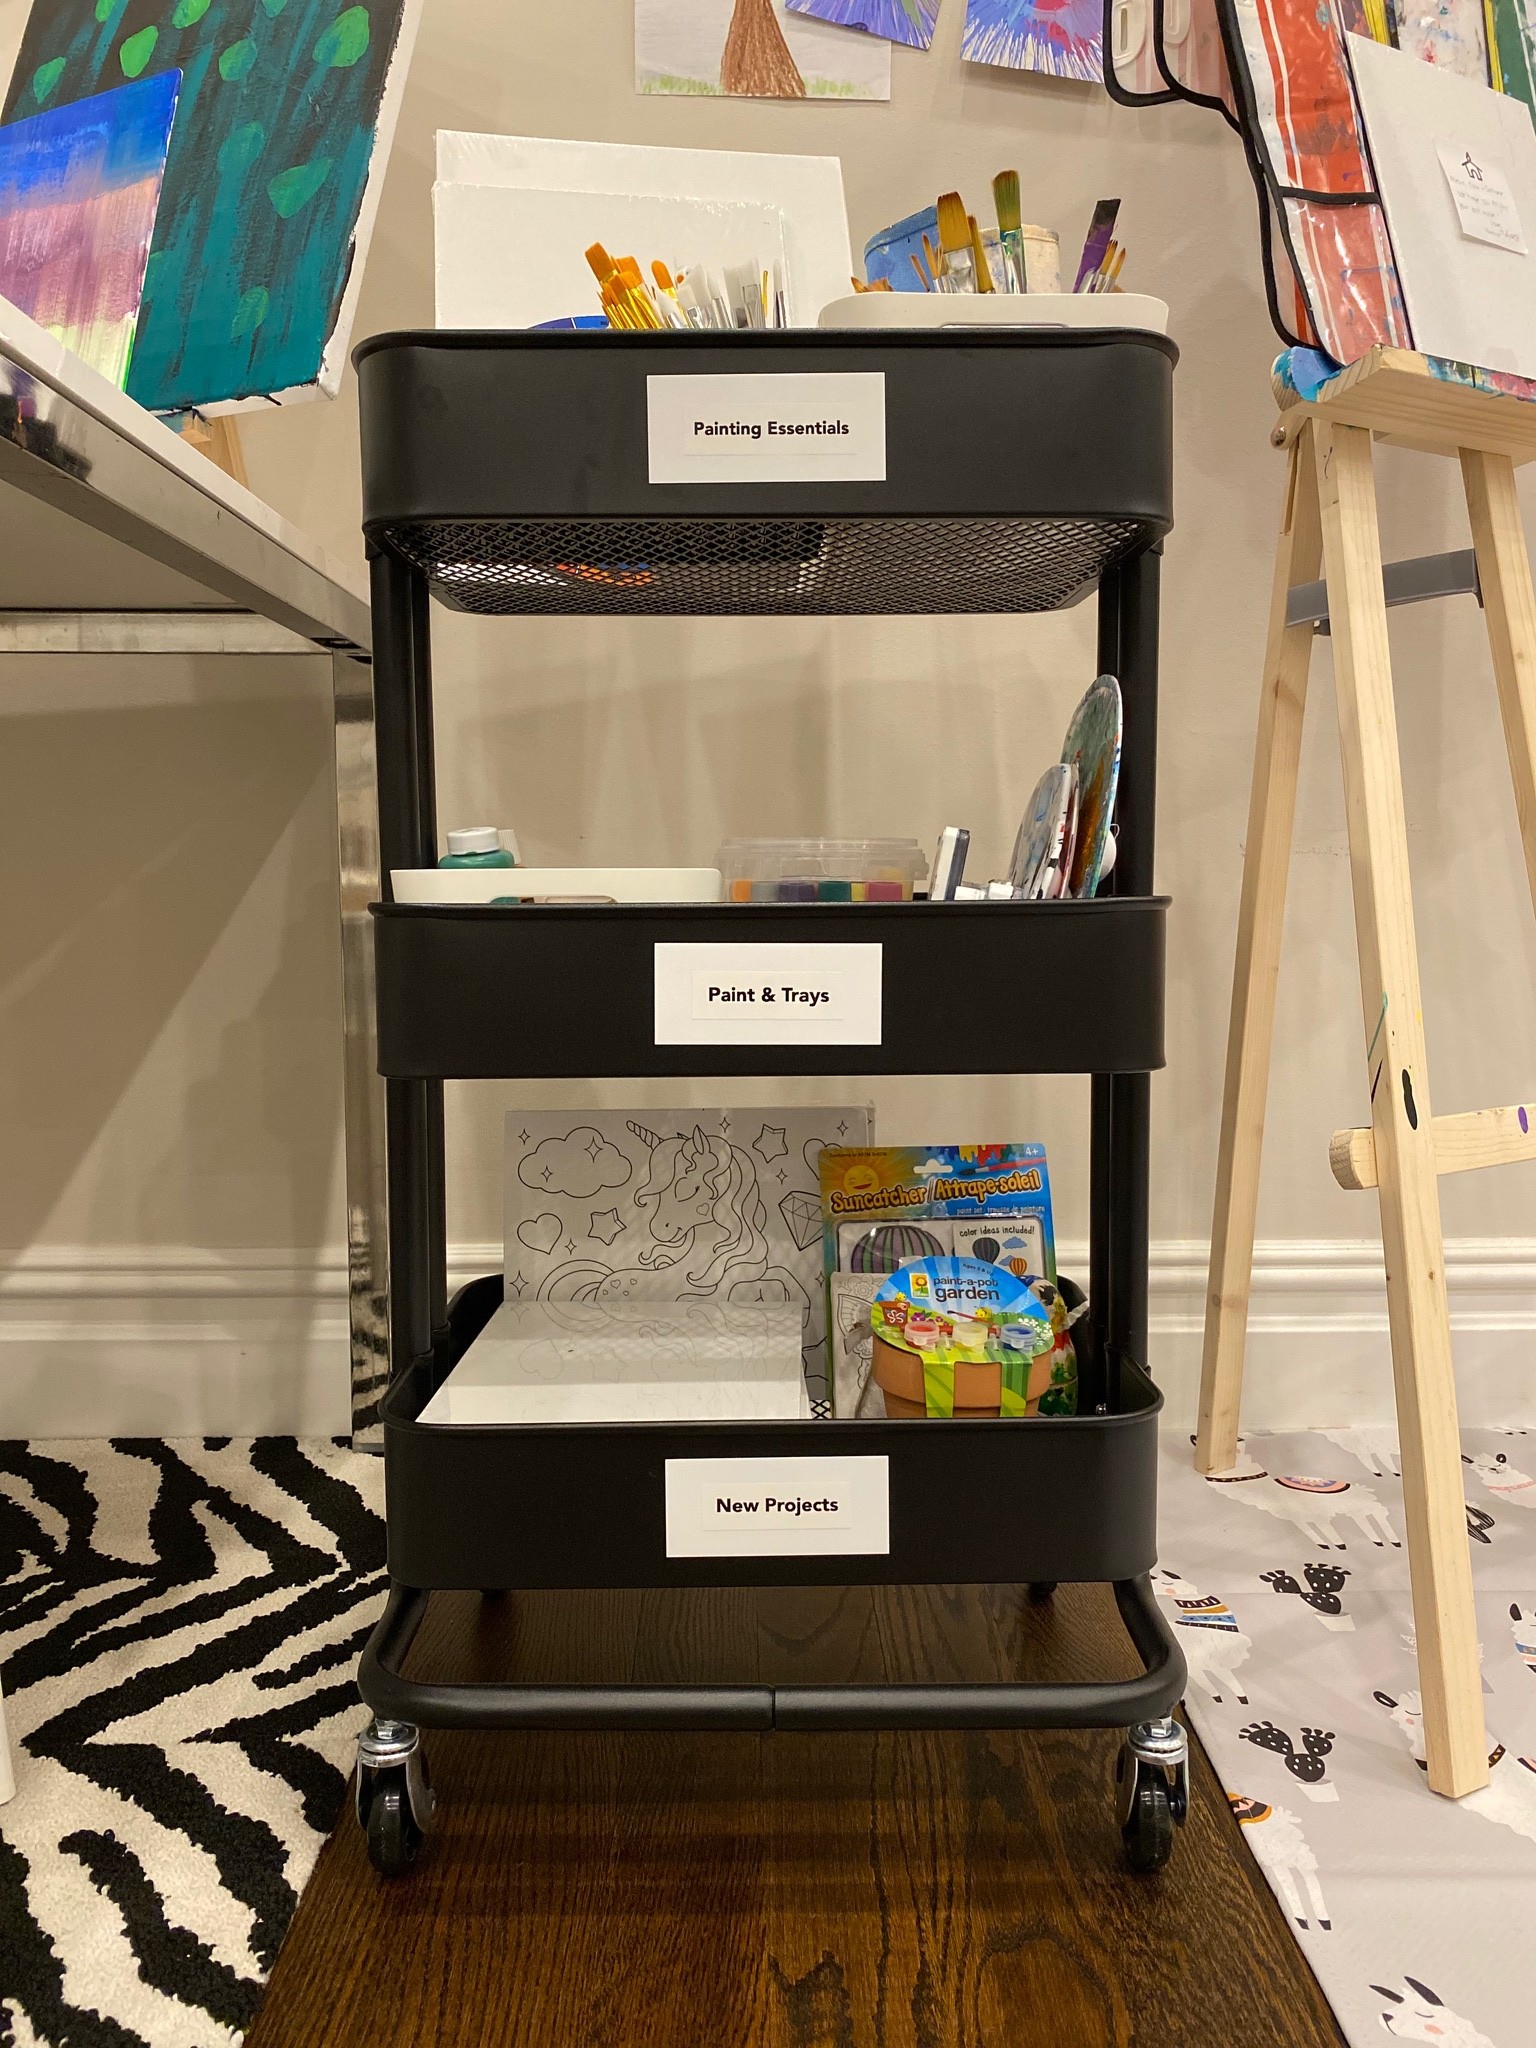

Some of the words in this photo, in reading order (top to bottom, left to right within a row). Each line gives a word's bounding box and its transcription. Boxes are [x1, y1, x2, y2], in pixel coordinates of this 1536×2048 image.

[693, 421, 762, 440] Painting
[767, 420, 850, 435] Essentials
[708, 986, 756, 1002] Paint
[761, 987, 776, 1002] &
[781, 987, 830, 1007] Trays
[1025, 1146, 1039, 1156] 4+
[959, 1228, 977, 1237] color
[980, 1225, 1000, 1235] ideas
[1002, 1225, 1035, 1235] included!
[933, 1276, 999, 1287] paint-a-pot
[934, 1286, 1000, 1303] garden
[716, 1498, 760, 1513] New
[765, 1497, 839, 1516] Projects
